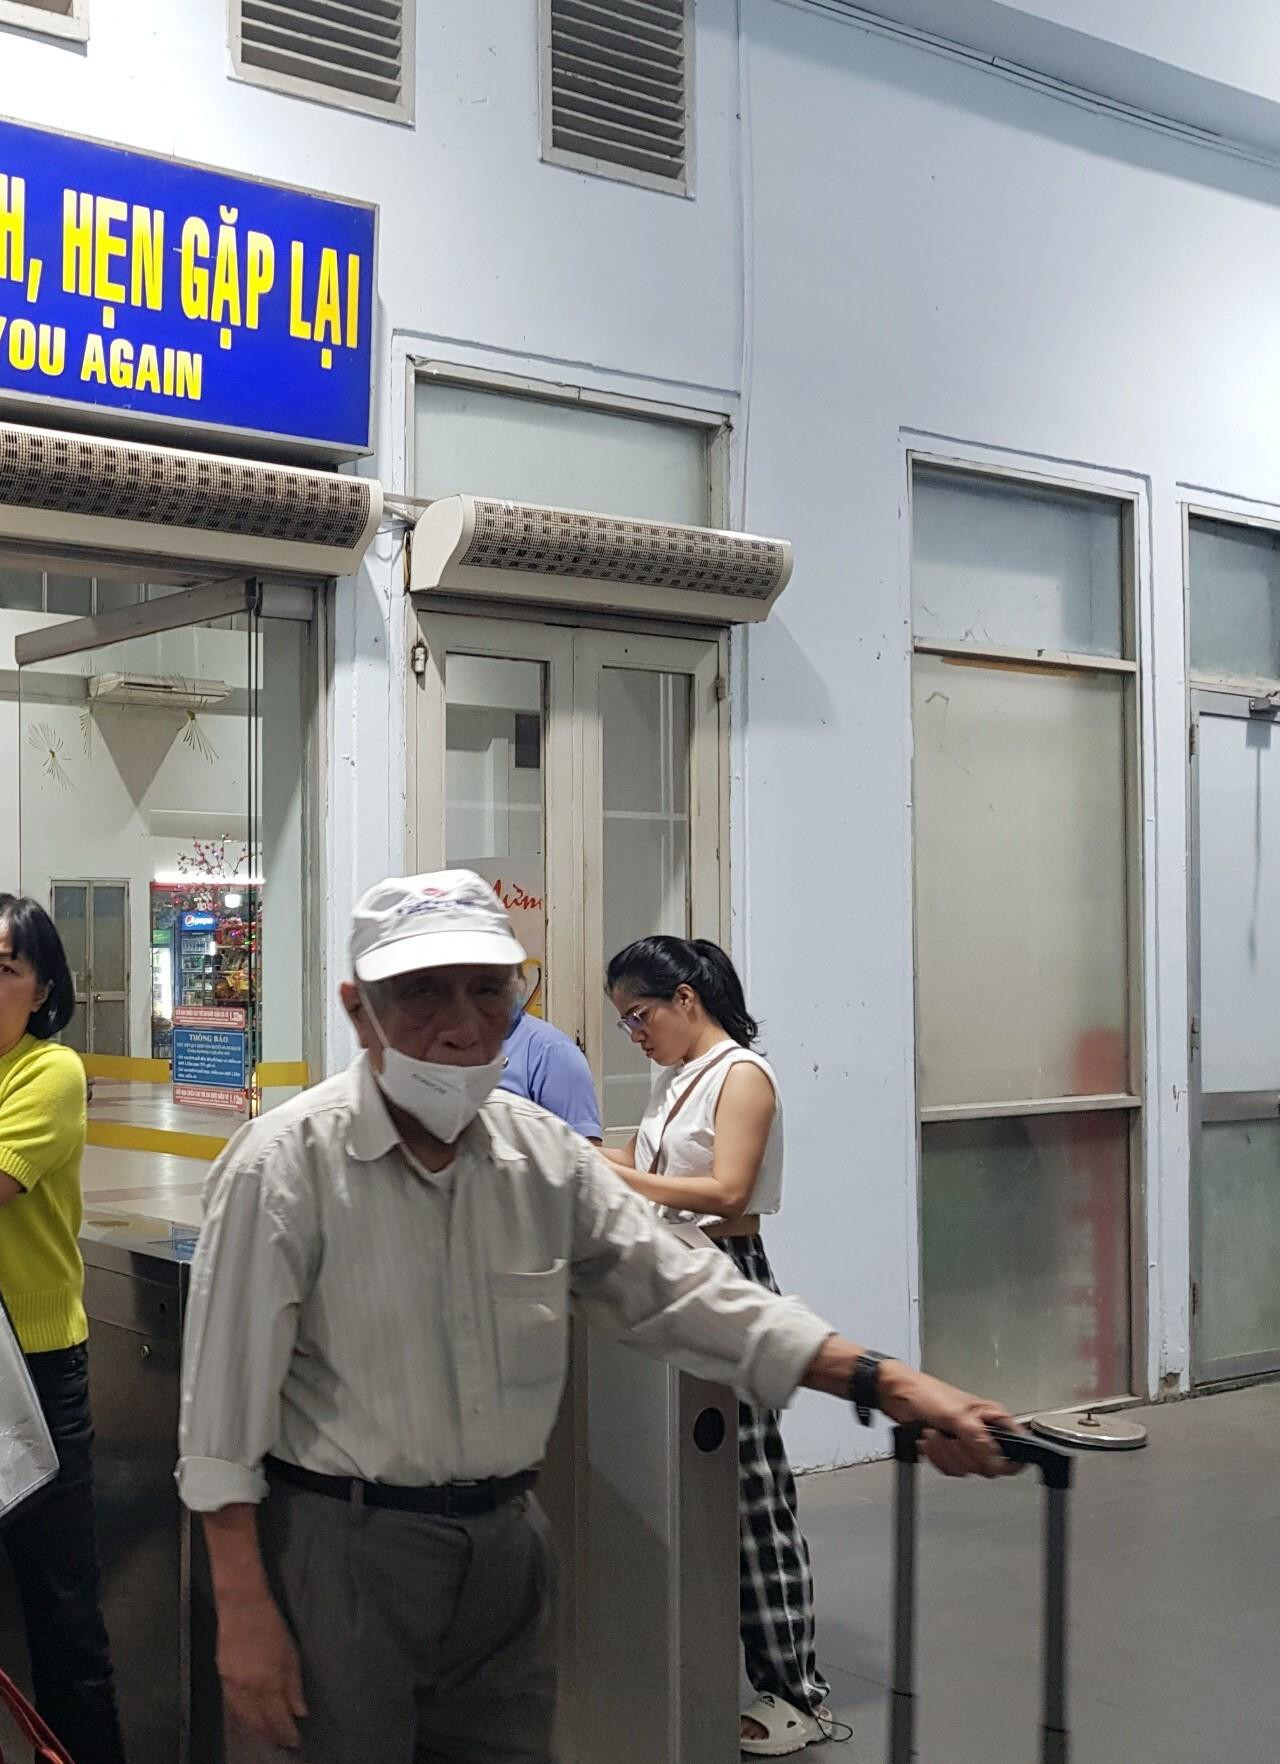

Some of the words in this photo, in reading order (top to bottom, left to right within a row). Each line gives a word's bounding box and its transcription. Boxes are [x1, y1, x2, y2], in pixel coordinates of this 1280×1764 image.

[62, 188, 165, 329] HẸN
[180, 205, 275, 350] GẶP
[288, 240, 360, 370] LẠI
[81, 334, 203, 401] AGAIN
